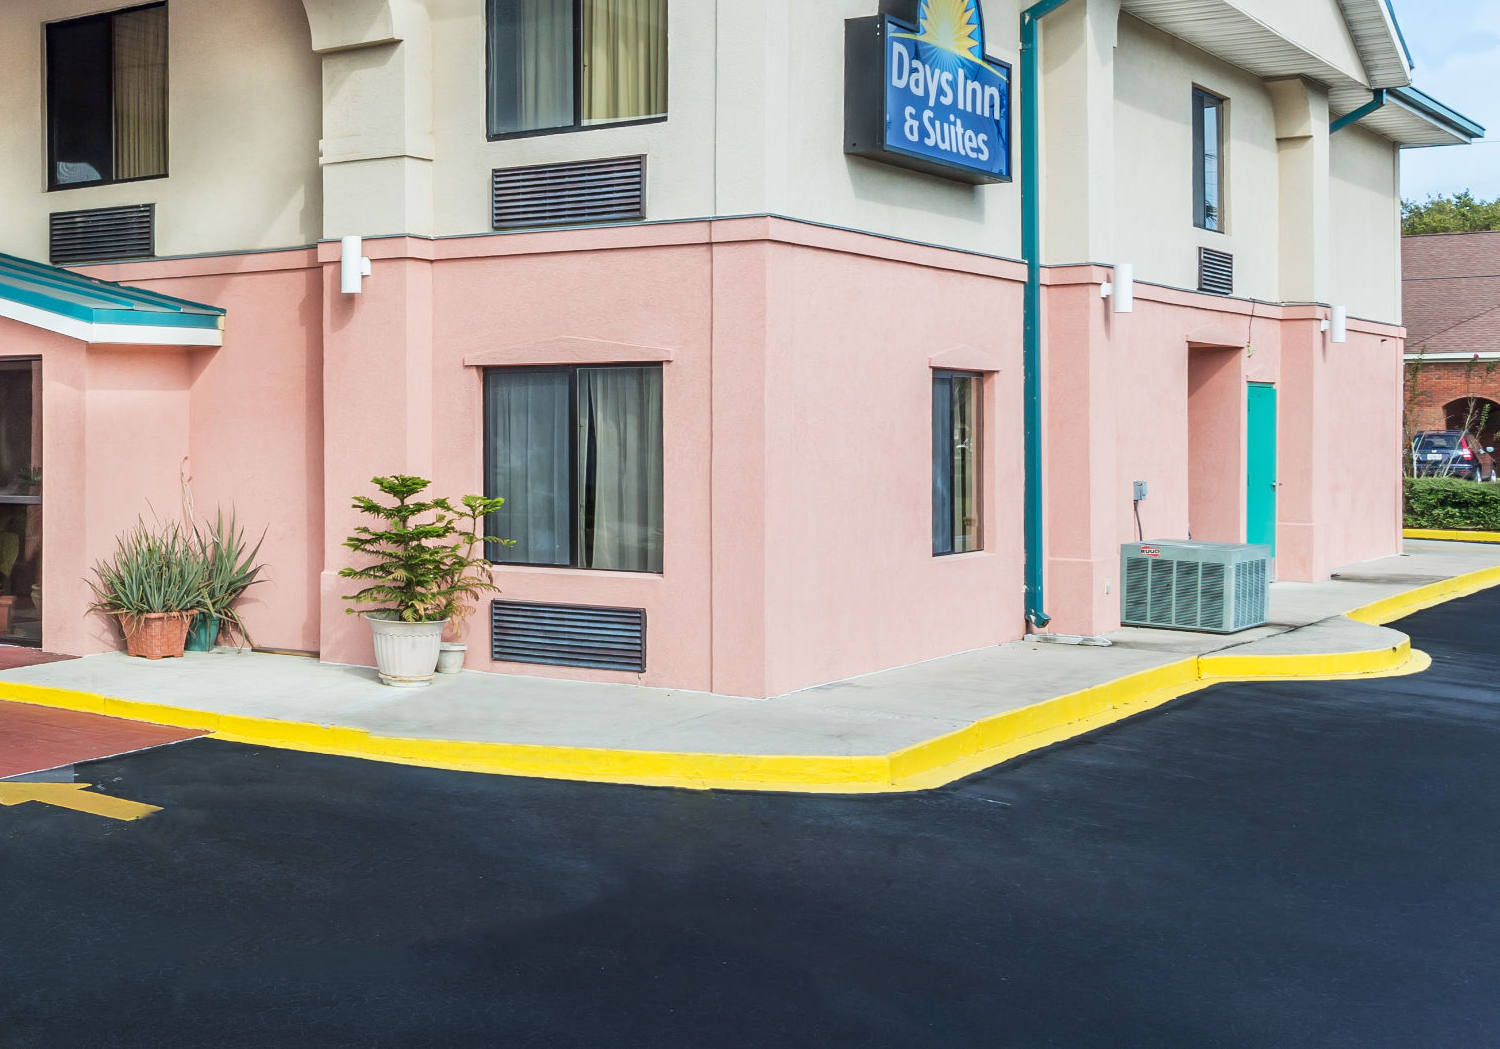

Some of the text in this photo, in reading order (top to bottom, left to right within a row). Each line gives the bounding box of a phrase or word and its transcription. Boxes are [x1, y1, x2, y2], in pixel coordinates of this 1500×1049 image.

[892, 41, 1000, 120] Days Inn
[904, 107, 989, 161] & Suites
